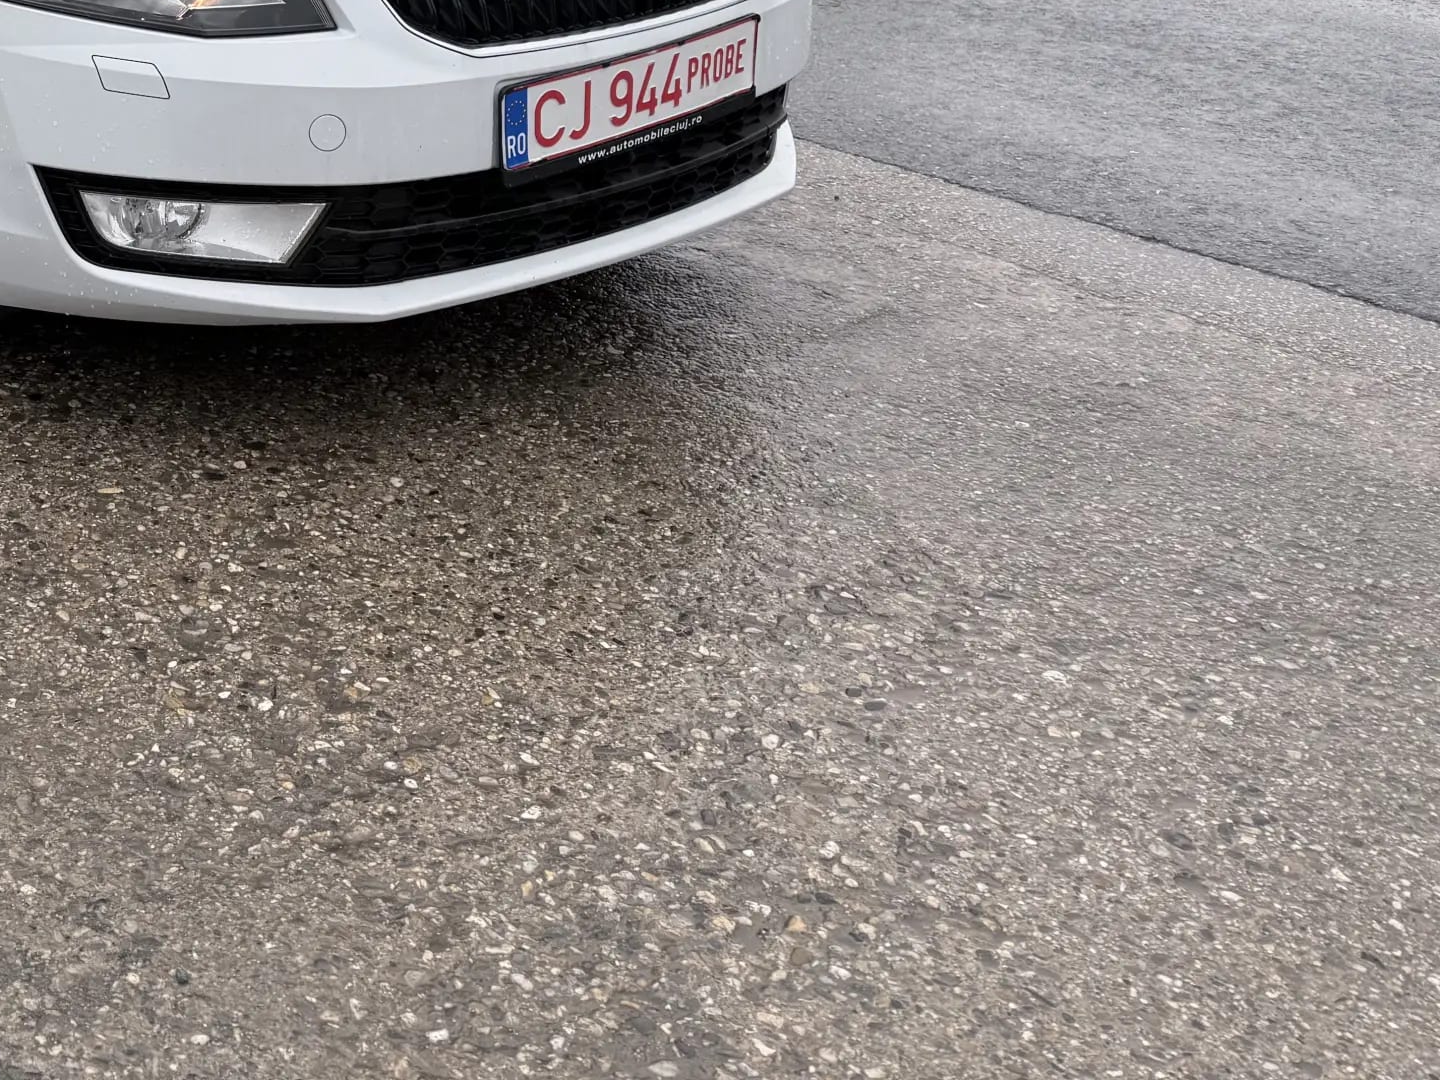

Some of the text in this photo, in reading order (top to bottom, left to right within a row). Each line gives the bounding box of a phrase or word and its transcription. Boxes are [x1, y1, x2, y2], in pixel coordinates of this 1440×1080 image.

[534, 38, 747, 148] CJ 944 PROBE
[507, 132, 527, 159] RO
[577, 114, 703, 165] www.automobilecluj.ro
